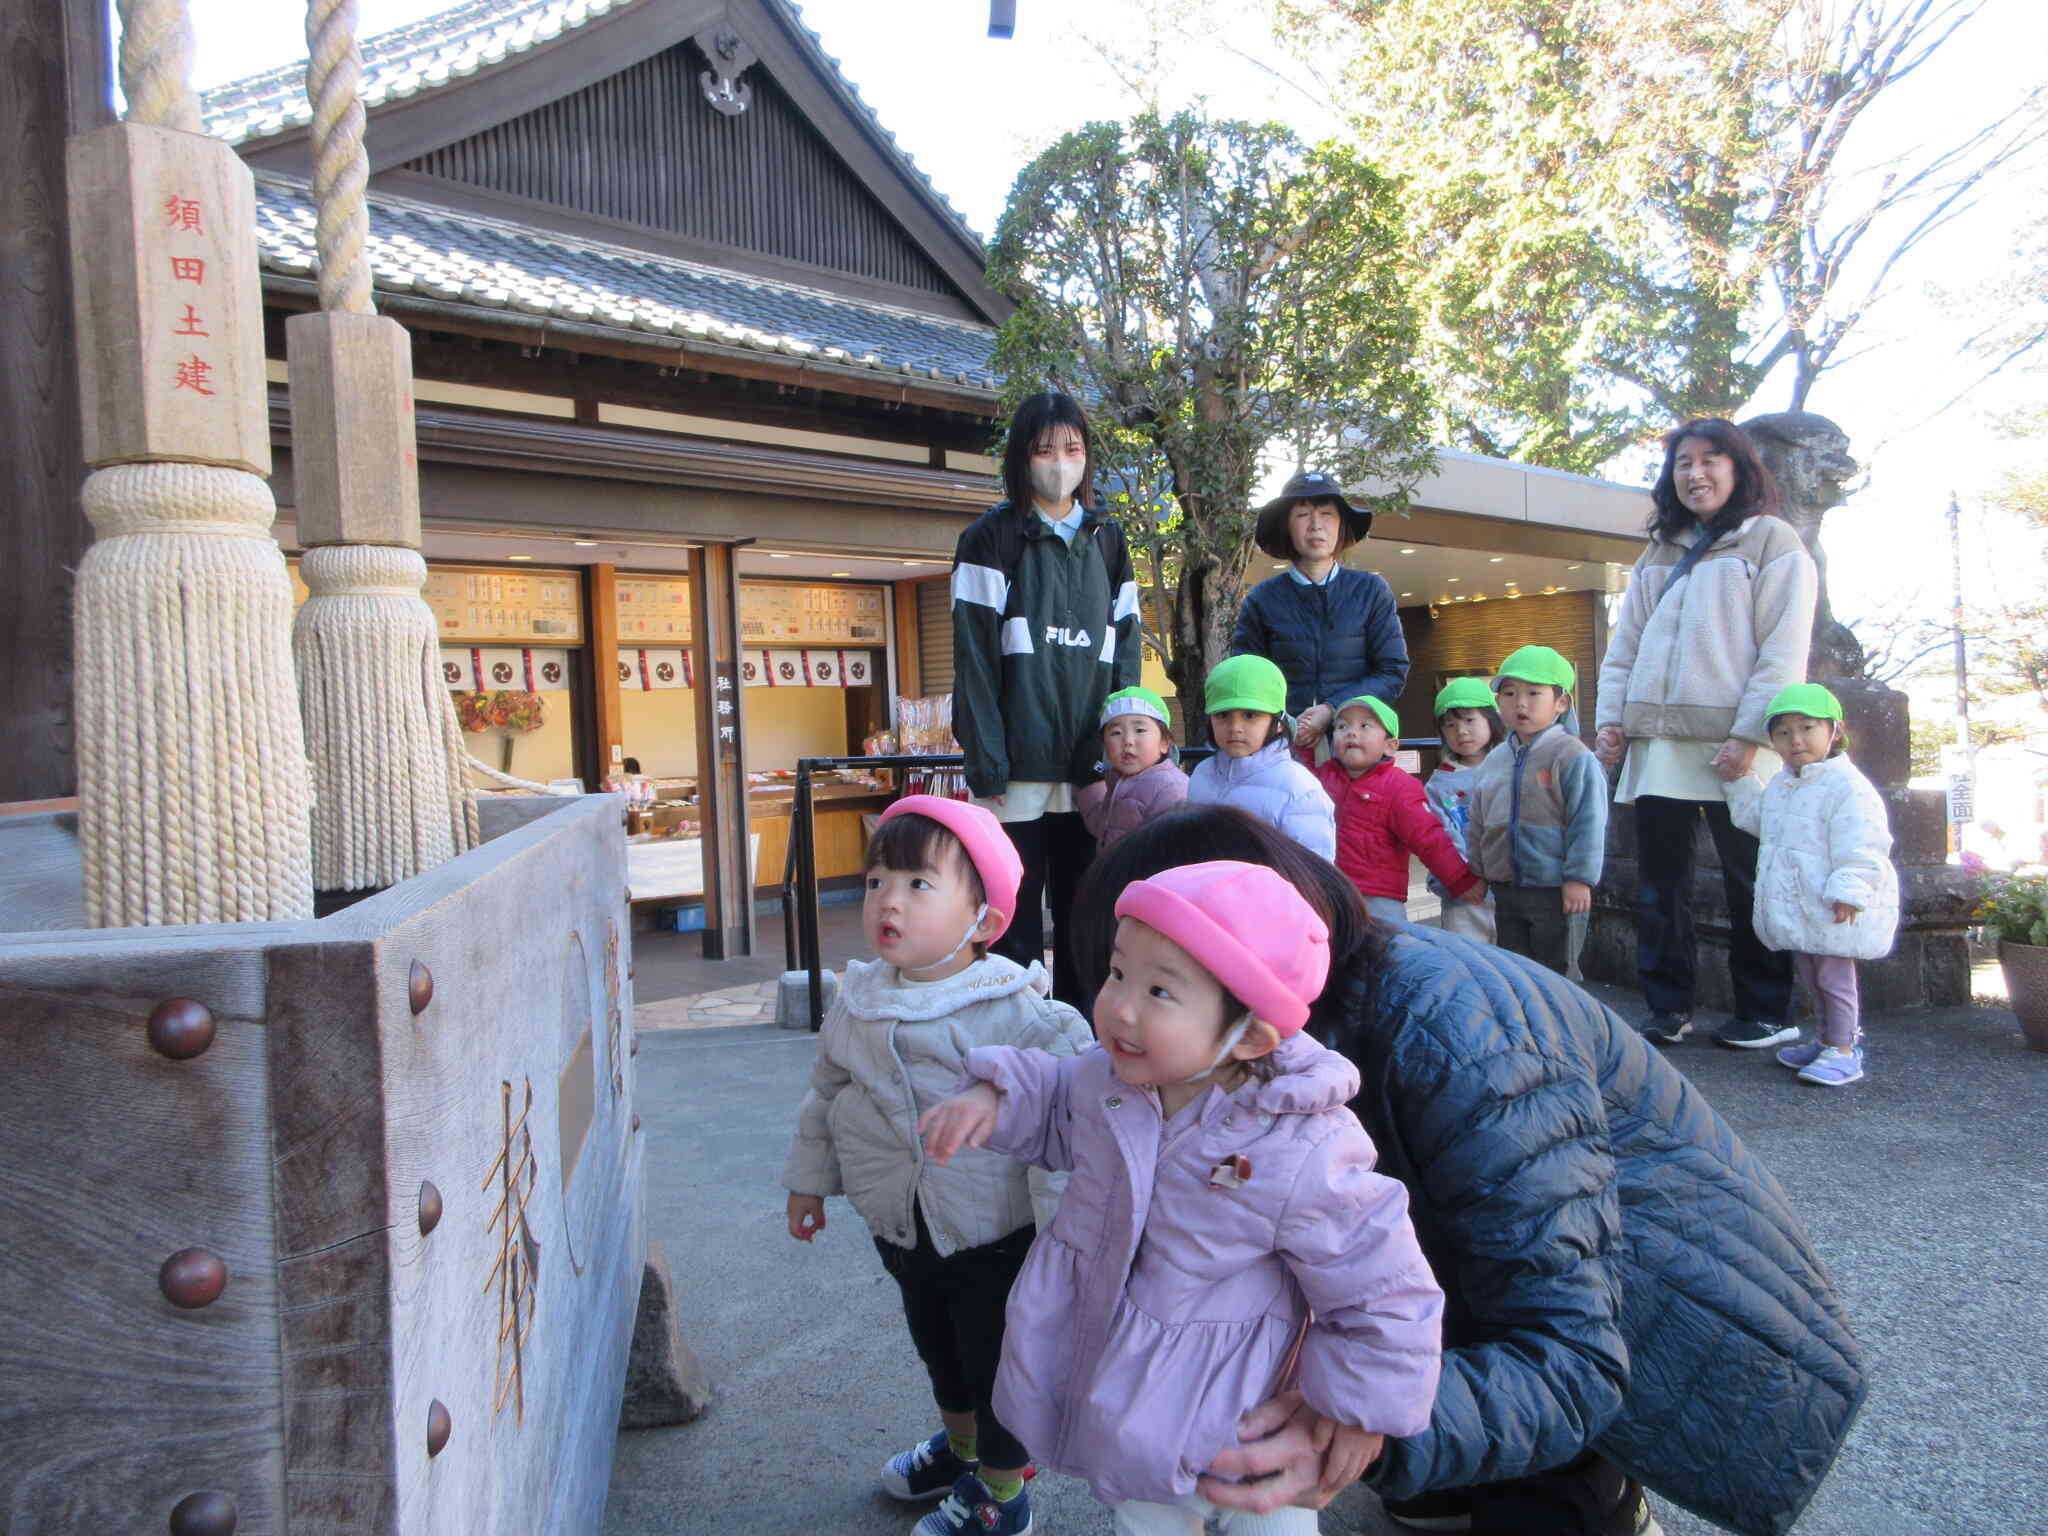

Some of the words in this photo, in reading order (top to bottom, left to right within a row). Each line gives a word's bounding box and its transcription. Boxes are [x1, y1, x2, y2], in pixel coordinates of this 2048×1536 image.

[164, 194, 216, 396] 須田土建
[1045, 625, 1092, 648] FILA
[716, 676, 735, 744] 社務所
